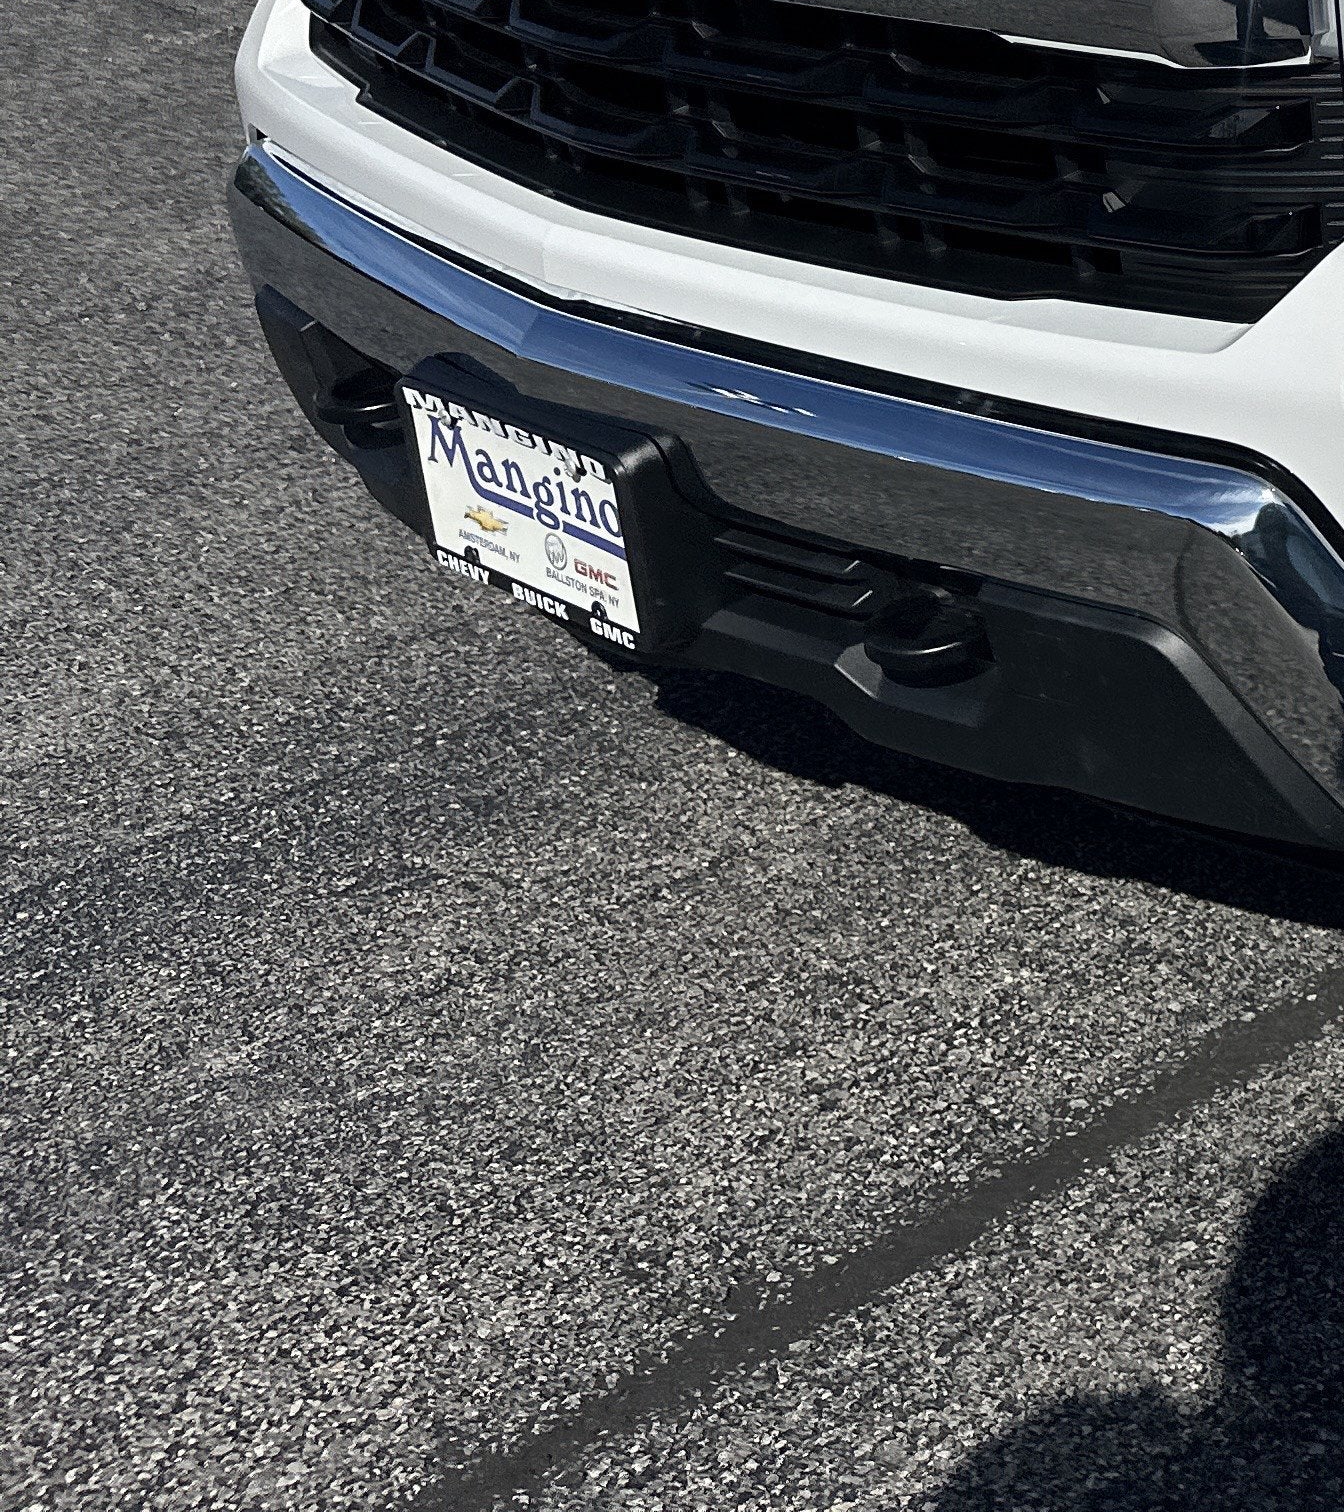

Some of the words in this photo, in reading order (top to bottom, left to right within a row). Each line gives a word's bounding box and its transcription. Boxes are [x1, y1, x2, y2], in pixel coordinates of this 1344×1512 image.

[402, 386, 613, 485] MANGINO
[427, 414, 623, 539] Mangino
[509, 550, 521, 564] NY
[546, 567, 588, 594] BALLSTON
[607, 596, 620, 609] NY
[574, 558, 620, 591] GMC
[436, 549, 490, 586] CHEVY
[511, 582, 570, 621] BUICK
[589, 616, 636, 651] GMC
